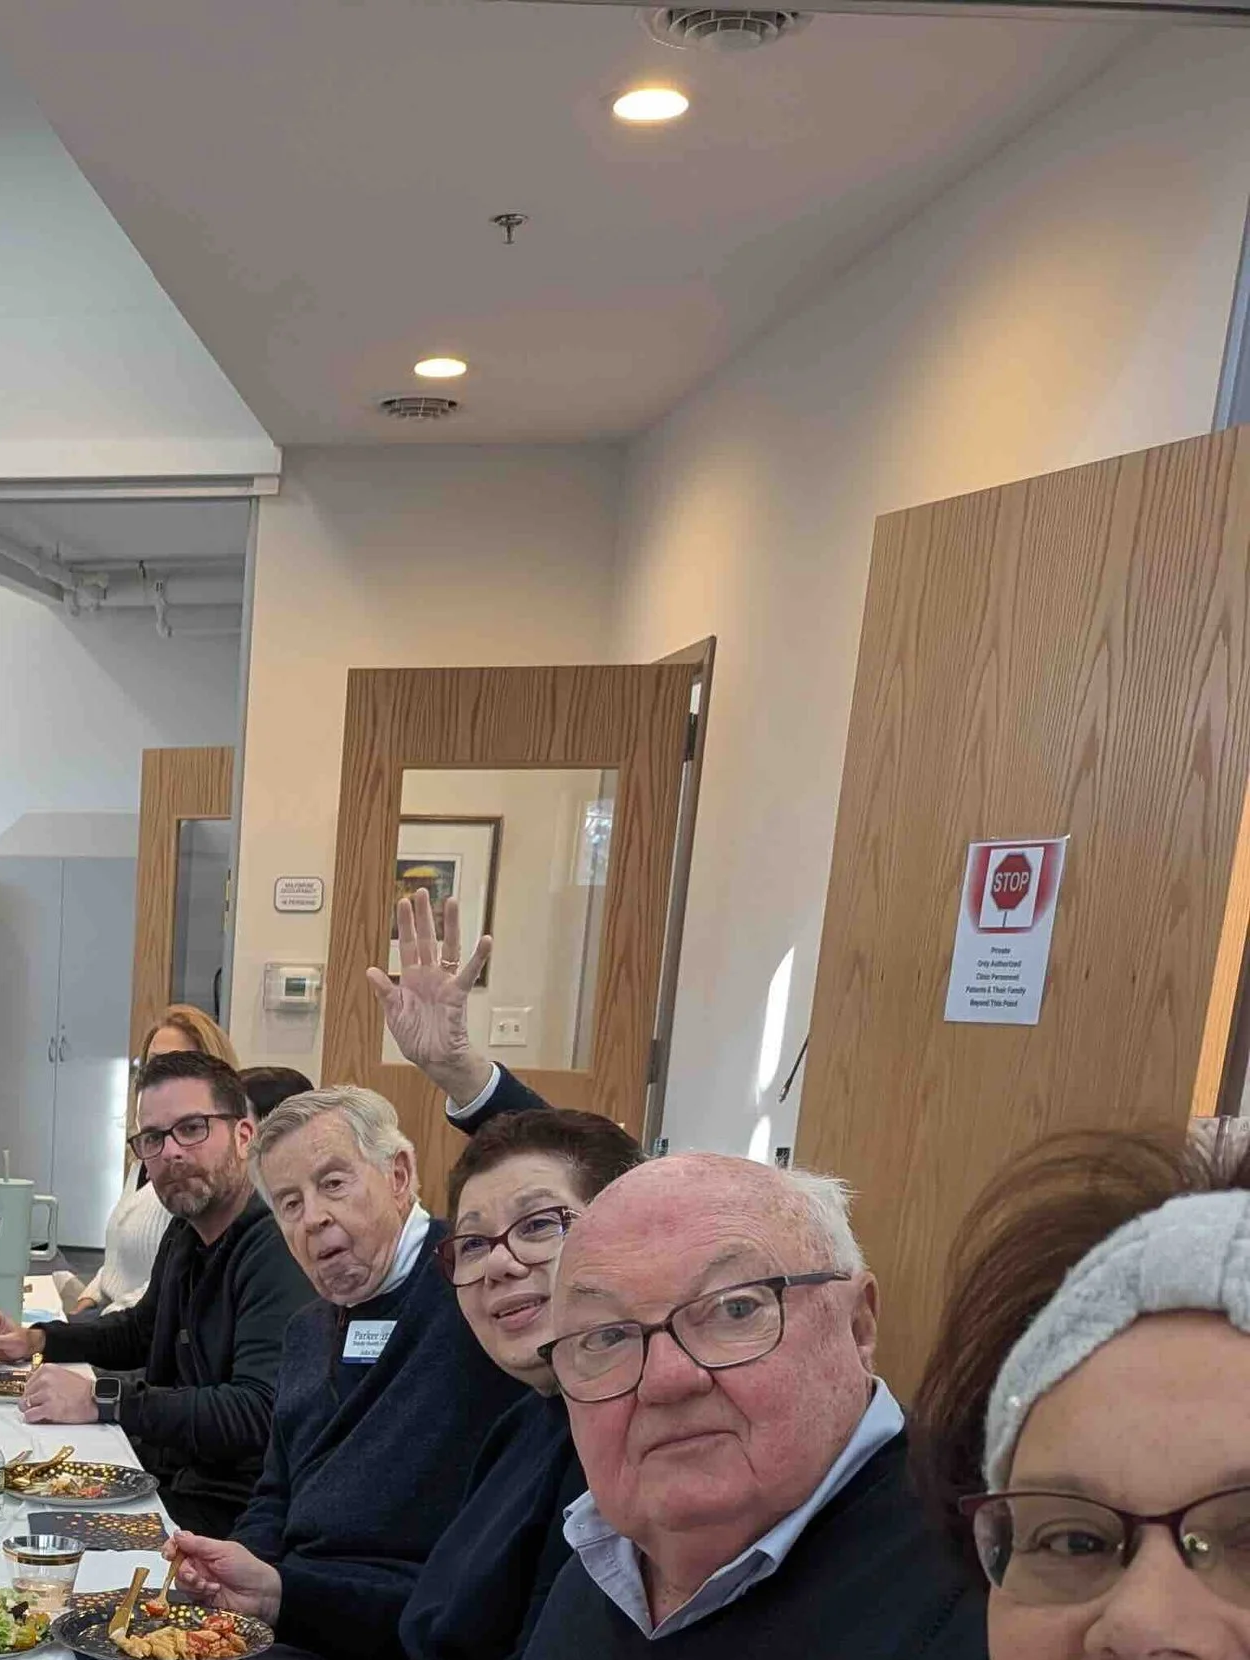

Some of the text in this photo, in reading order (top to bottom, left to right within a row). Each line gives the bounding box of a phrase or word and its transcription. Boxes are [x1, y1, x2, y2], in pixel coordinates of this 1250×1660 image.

[993, 871, 1030, 892] STOP
[977, 959, 1022, 968] Only Authorized
[1007, 985, 1027, 996] Family
